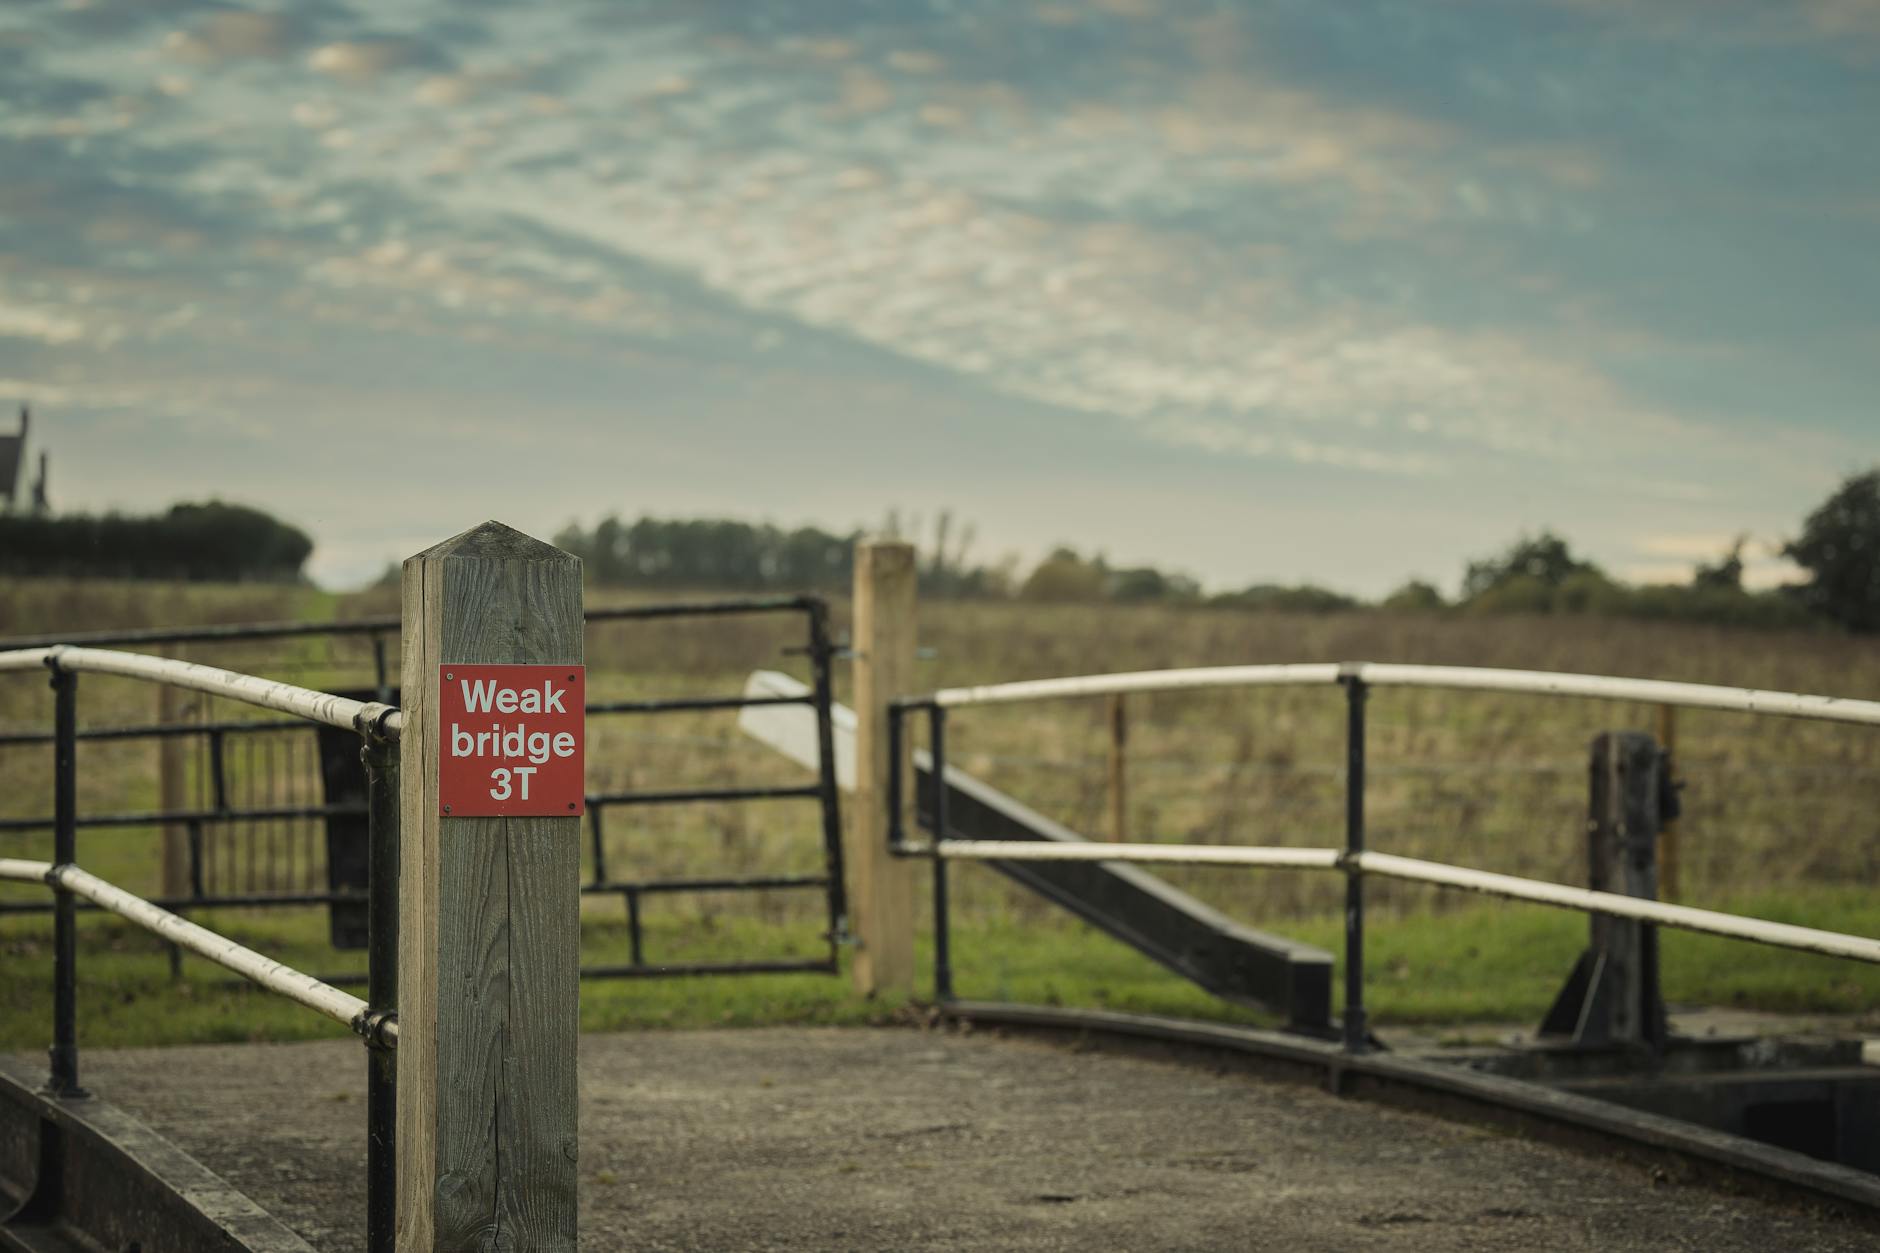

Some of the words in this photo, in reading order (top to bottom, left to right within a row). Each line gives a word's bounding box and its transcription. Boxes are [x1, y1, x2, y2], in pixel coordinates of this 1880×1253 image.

[460, 679, 567, 714] Weak
[451, 723, 576, 764] bridge
[489, 766, 538, 801] 3T
